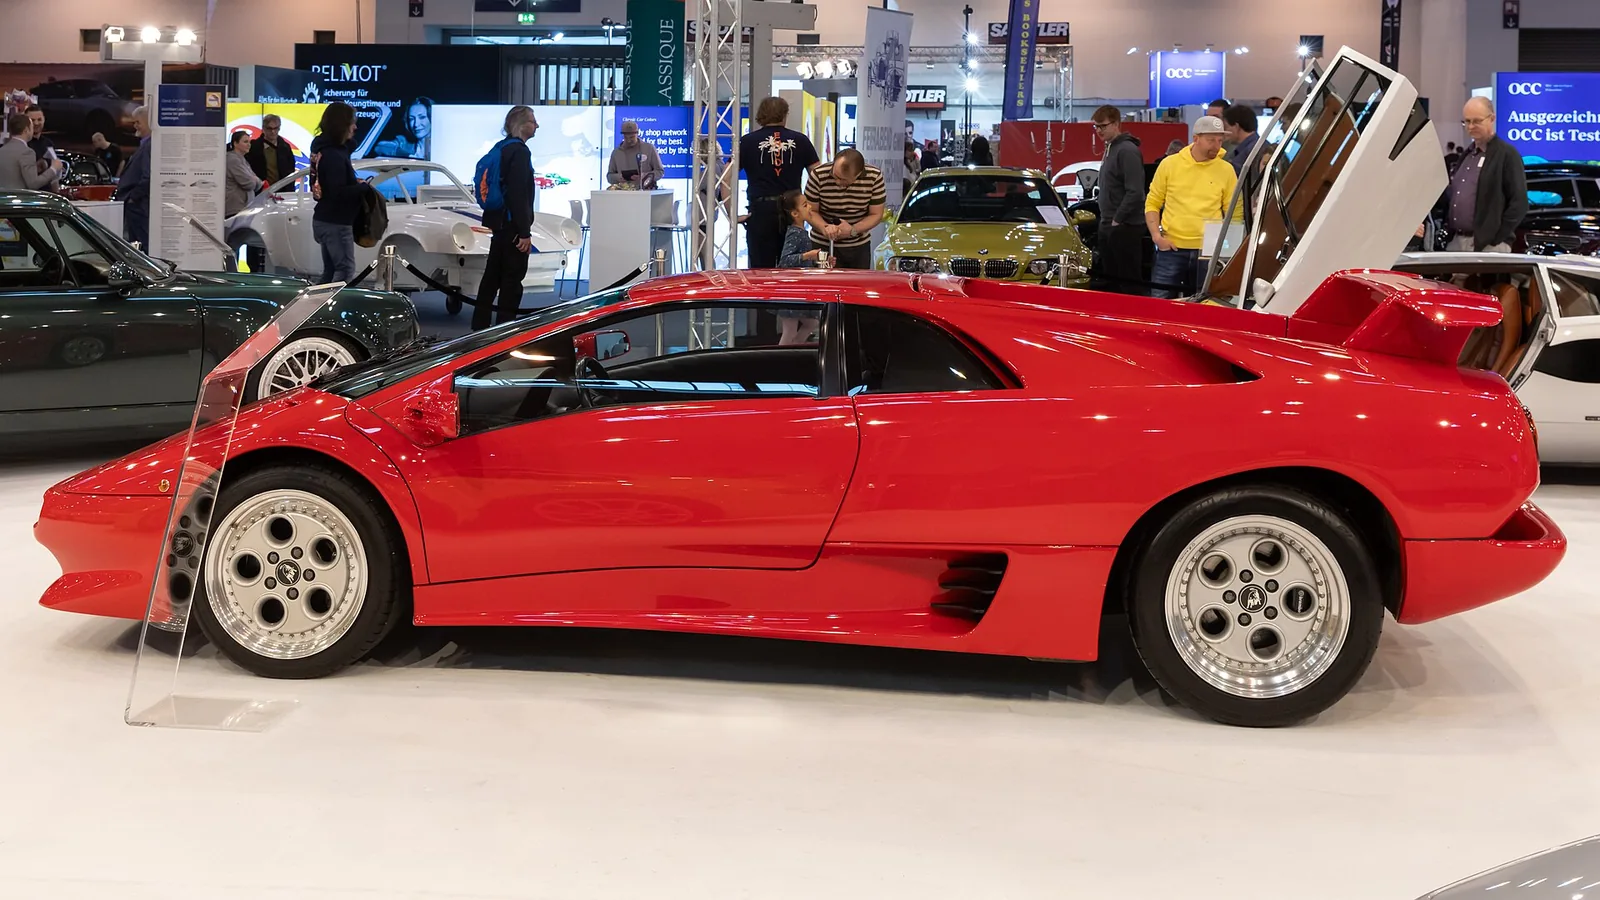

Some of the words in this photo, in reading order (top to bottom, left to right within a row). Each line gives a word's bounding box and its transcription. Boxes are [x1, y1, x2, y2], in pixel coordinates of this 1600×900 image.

[1017, 14, 1030, 107] BOOKSELLERS
[1166, 68, 1192, 79] OCC
[324, 88, 356, 98] icherung
[357, 88, 368, 97] für
[1508, 82, 1542, 95] OCC
[356, 111, 382, 119] rzeuge.
[1508, 110, 1600, 126] Ausgezeich
[645, 129, 661, 137] shop
[1507, 128, 1543, 141] OCC
[1545, 128, 1565, 141] ist
[1567, 129, 1600, 141] Test
[646, 138, 656, 146] for
[668, 147, 677, 155] by
